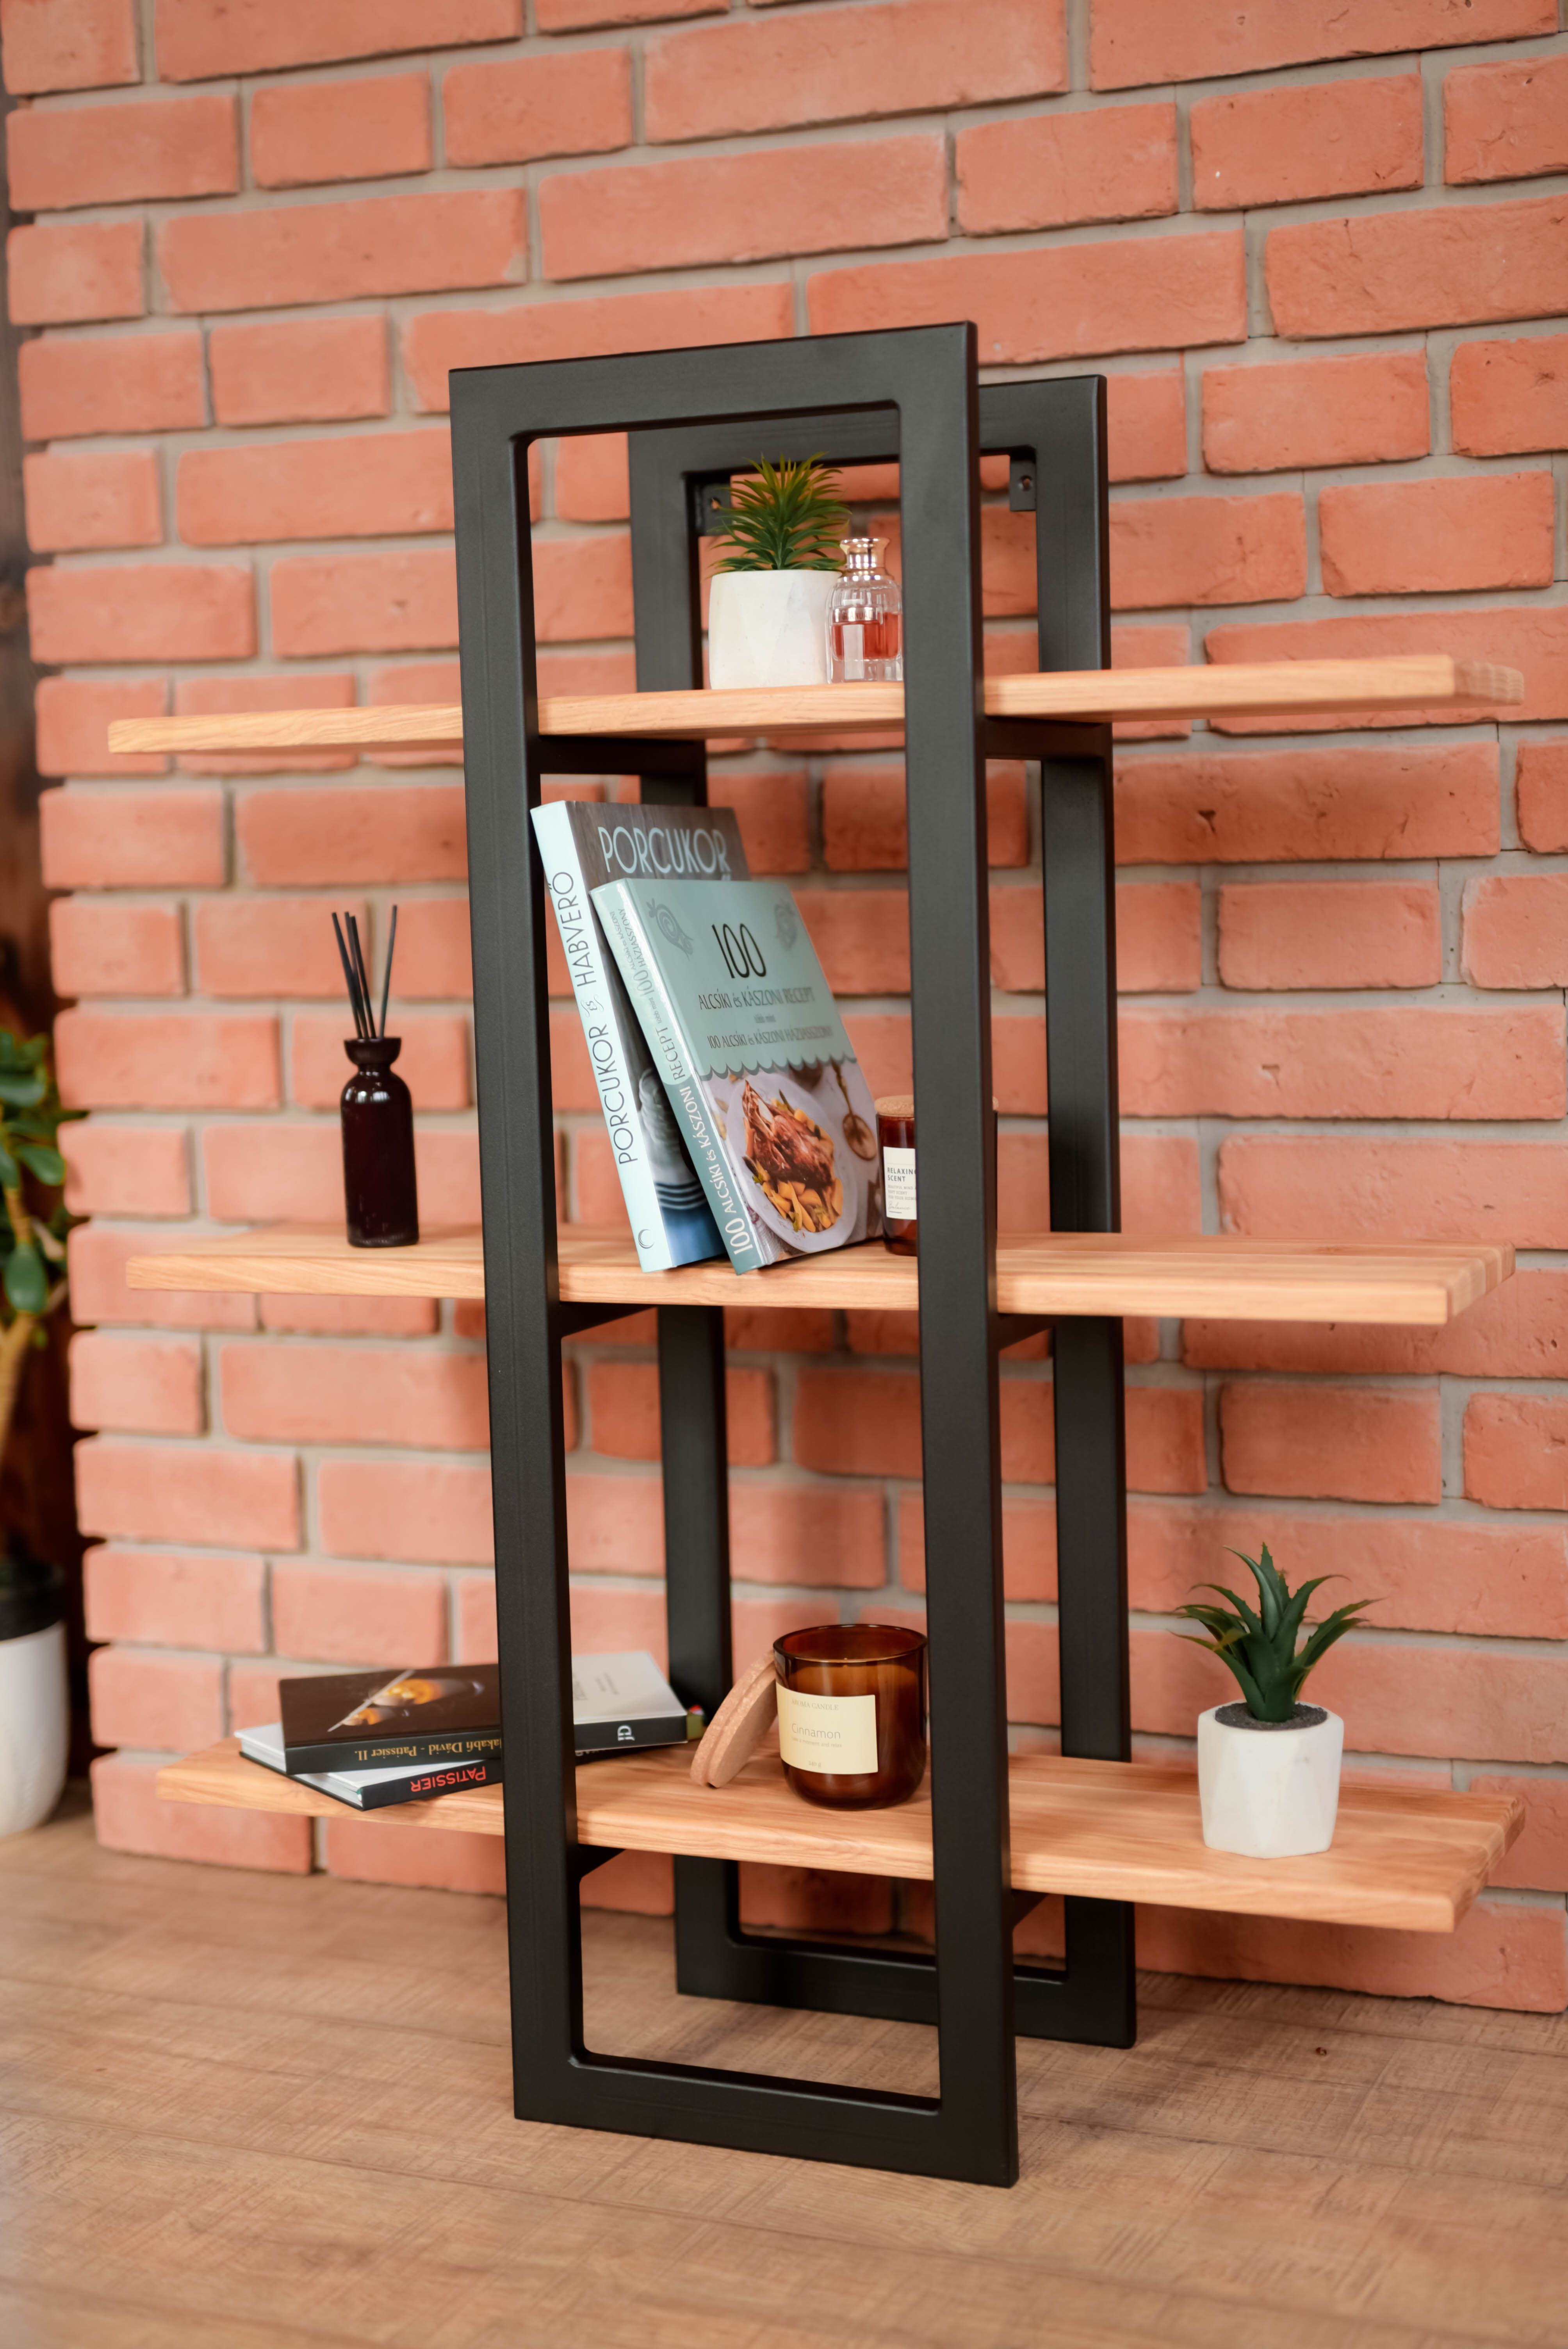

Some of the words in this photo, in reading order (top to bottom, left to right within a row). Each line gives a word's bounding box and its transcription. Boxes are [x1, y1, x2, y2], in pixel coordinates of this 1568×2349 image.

[598, 826, 732, 873] PORCUKOR
[548, 872, 597, 987] HABVERŐ
[618, 909, 646, 967] HÁZIASSZONY
[712, 923, 766, 978] 100
[633, 970, 655, 997] 100
[698, 989, 732, 1010] ALCSÍKI
[733, 993, 743, 1007] és
[741, 986, 784, 1007] KÁSZONI
[656, 1027, 686, 1081] RECEPT
[707, 1035, 721, 1049] 100
[722, 1031, 748, 1048] ALCSÍKI
[753, 1028, 784, 1044] KÁSZONI
[589, 1024, 638, 1164] PORCUKOR
[679, 1085, 711, 1149] KÁSZONI
[709, 1149, 716, 1161] és
[709, 1164, 737, 1214] ALCSÍKI
[725, 1218, 754, 1255] 100
[812, 1702, 839, 1711] CANDLE
[429, 1742, 463, 1756] Dávid
[791, 1723, 841, 1739] Cinnamon
[371, 1746, 417, 1759] Patissier
